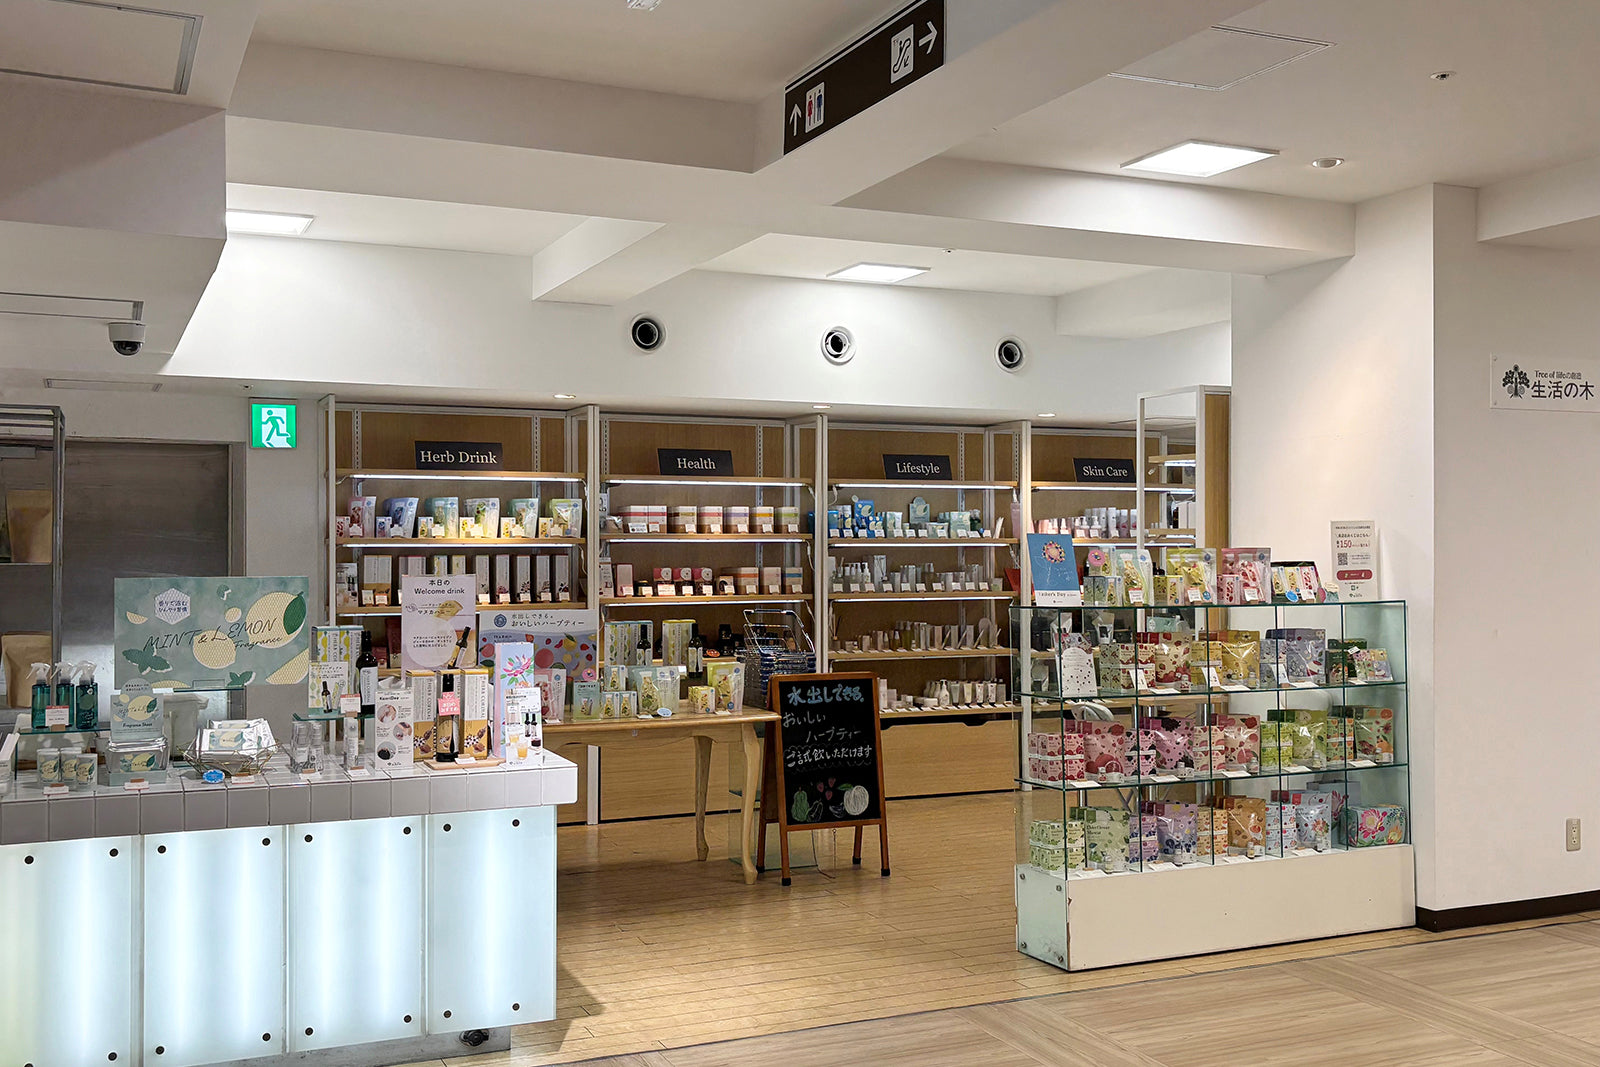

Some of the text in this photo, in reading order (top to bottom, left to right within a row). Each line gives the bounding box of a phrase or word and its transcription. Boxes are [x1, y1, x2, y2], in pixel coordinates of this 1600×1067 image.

[1534, 370, 1548, 379] Tree
[1530, 380, 1595, 401] 生活の木
[420, 450, 498, 464] Herb Drink
[676, 457, 717, 470] Health
[896, 462, 941, 476] Lifestyle
[1082, 465, 1128, 477] Skin Care
[1340, 539, 1352, 549] 150
[511, 619, 585, 627] おいしいハーブティー
[143, 617, 278, 651] MINT & LEMON
[234, 636, 283, 651] Fragrance
[783, 711, 826, 728] おいしい
[805, 727, 862, 743] ハーブティー
[786, 744, 873, 768] ご試飲いただけます
